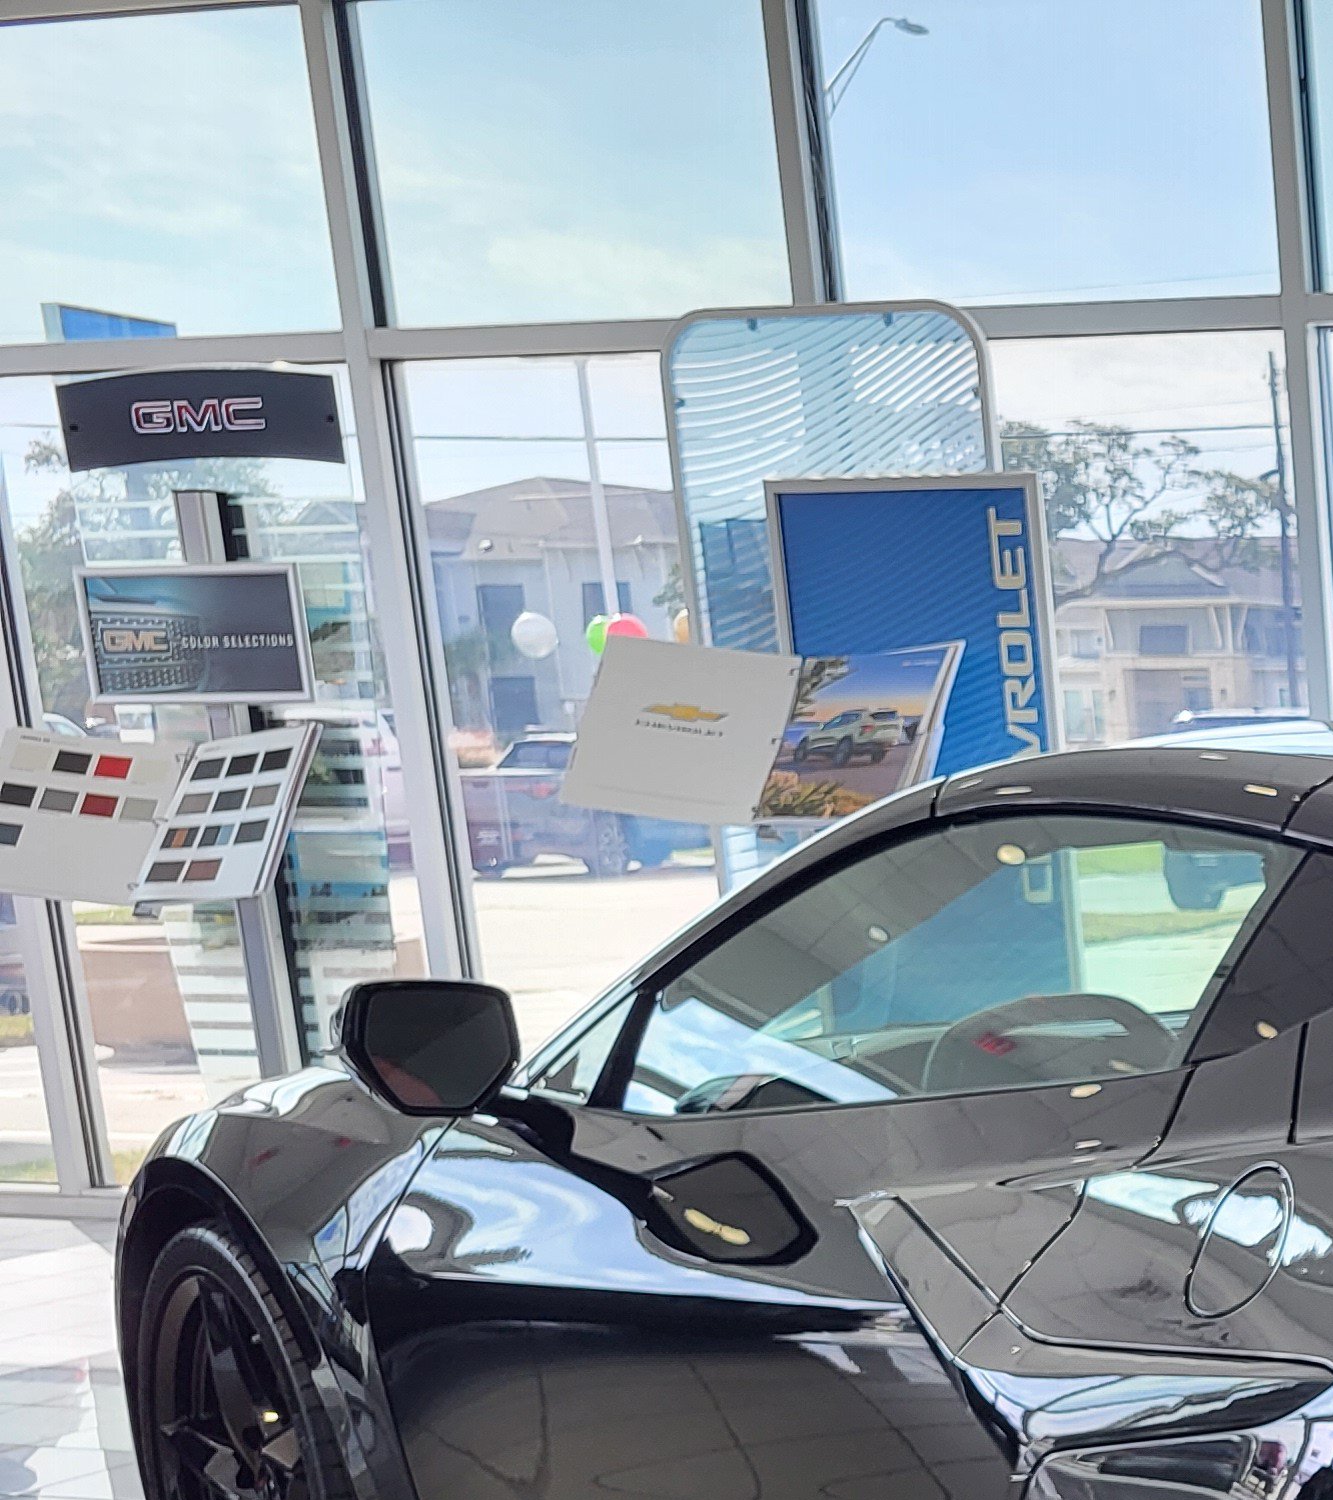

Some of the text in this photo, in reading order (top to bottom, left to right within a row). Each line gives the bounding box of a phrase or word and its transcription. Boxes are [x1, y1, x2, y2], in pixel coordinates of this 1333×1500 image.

[131, 397, 266, 434] GMC
[103, 629, 294, 651] GMC COLOR SELECTIONS
